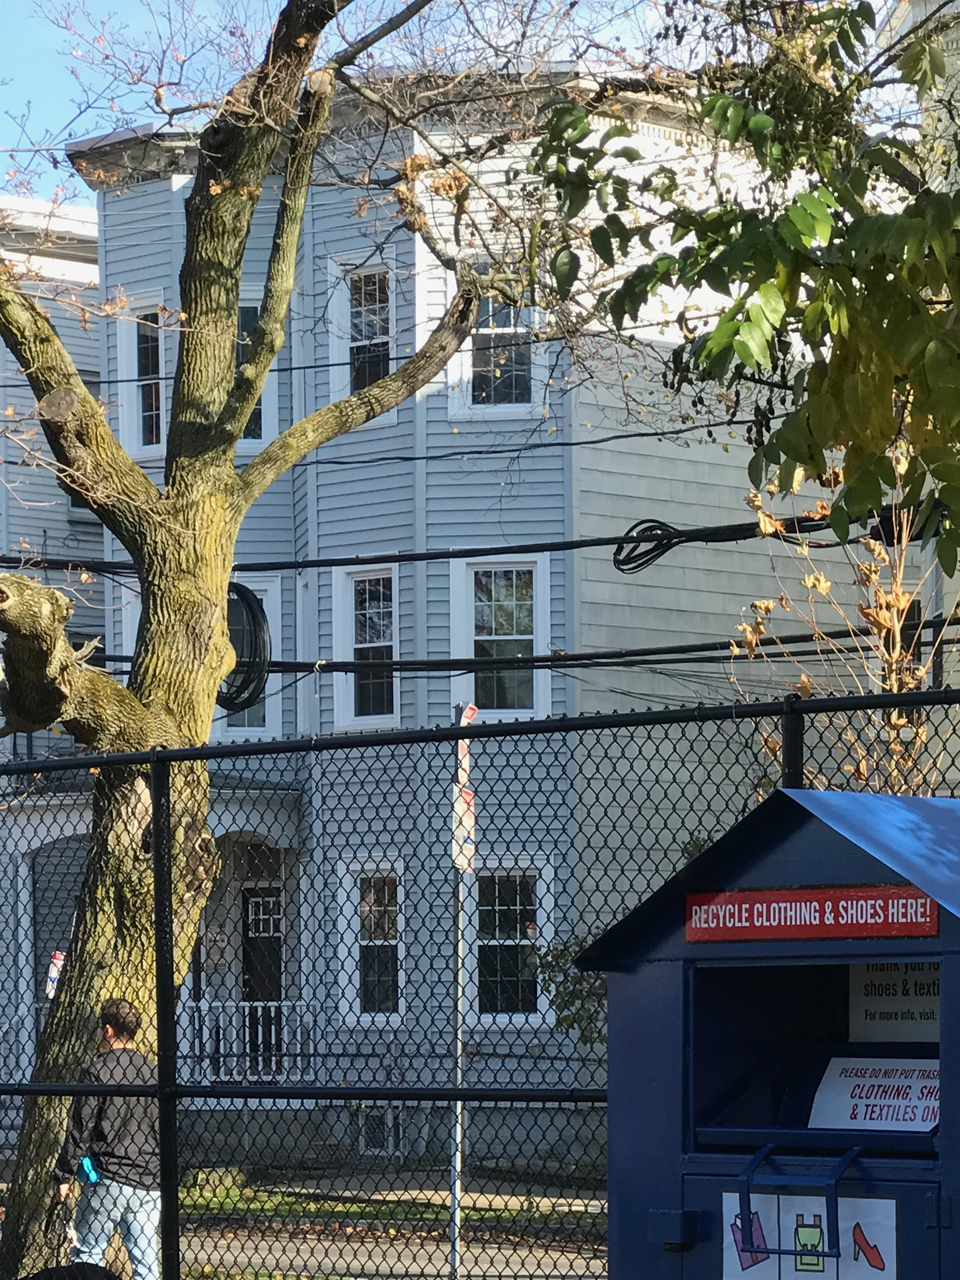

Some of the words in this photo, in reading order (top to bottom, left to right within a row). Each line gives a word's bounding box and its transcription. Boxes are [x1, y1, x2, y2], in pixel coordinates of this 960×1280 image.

[692, 904, 749, 928] RECYCLE
[754, 902, 819, 926] CLOTHING
[824, 901, 834, 924] &
[838, 899, 883, 924] SHOES
[888, 898, 930, 922] HERE!
[864, 979, 898, 997] shoes
[901, 979, 910, 997] &
[864, 1009, 877, 1021] For
[879, 1010, 898, 1021] more
[900, 1009, 918, 1022] info,
[919, 1009, 937, 1021] visit:
[839, 1067, 869, 1078] PLEASE
[869, 1068, 880, 1079] DO
[882, 1068, 900, 1079] NOT
[900, 1069, 916, 1080] PUT
[850, 1084, 912, 1103] CLOTHING,
[850, 1103, 858, 1120] &
[863, 1104, 918, 1122] TEXTILES
